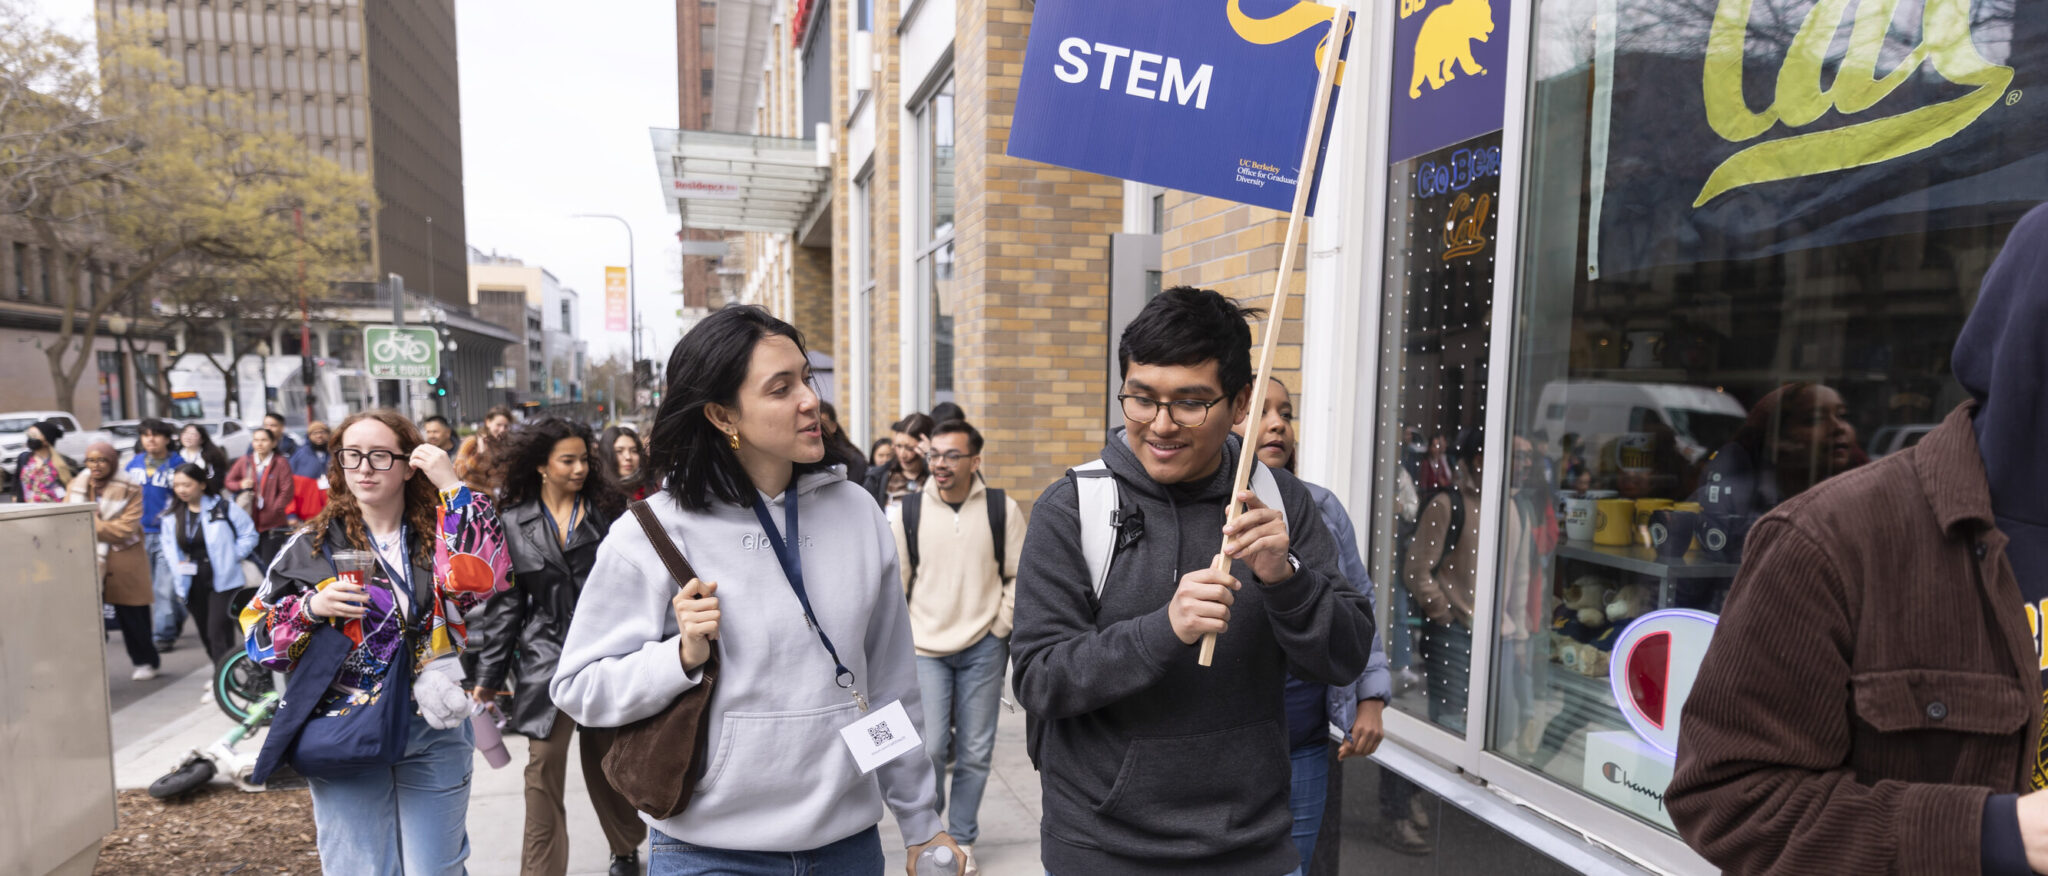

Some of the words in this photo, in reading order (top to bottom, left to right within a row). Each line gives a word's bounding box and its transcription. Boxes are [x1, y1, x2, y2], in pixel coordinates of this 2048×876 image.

[1054, 37, 1214, 110] STEM
[1240, 159, 1251, 167] UC
[1252, 161, 1280, 174] Berkeley
[1236, 174, 1265, 188] Diversity
[1238, 167, 1257, 177] Office
[1257, 170, 1267, 179] for
[1267, 173, 1298, 185] Graduate
[1442, 193, 1490, 260] Cal
